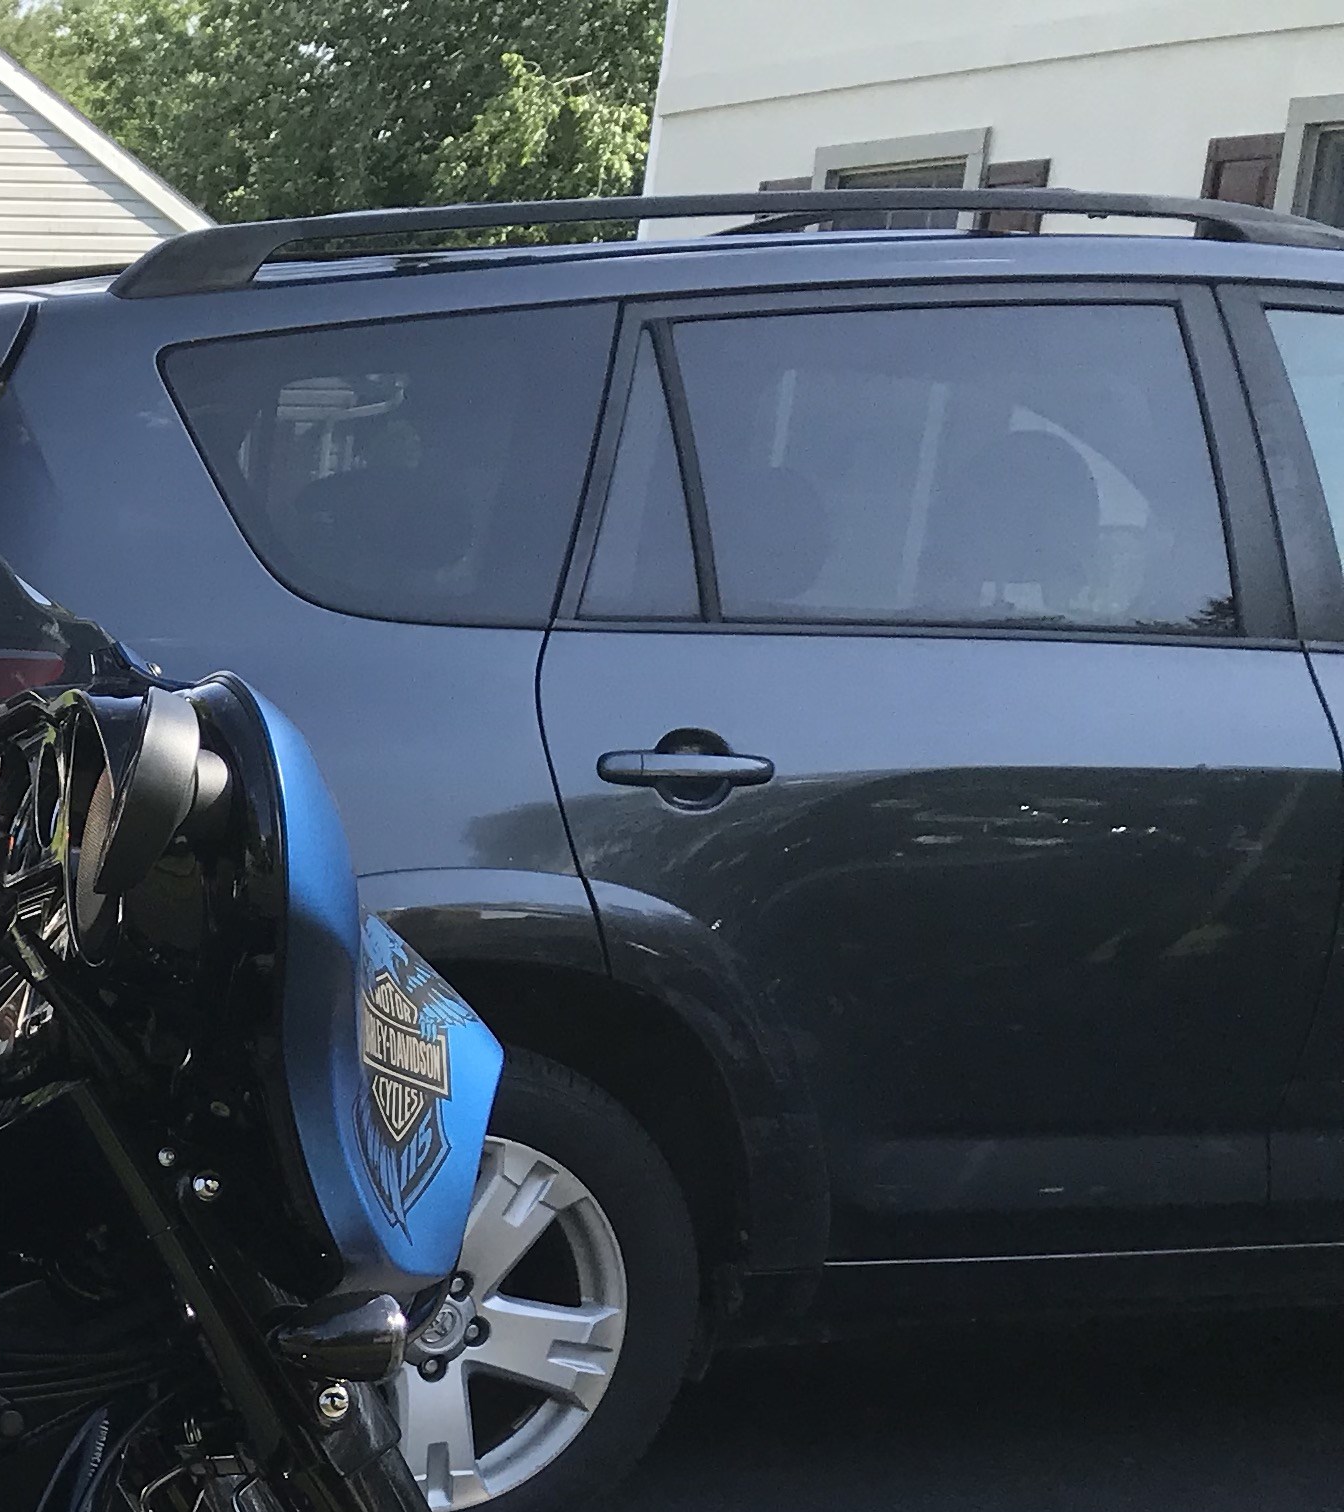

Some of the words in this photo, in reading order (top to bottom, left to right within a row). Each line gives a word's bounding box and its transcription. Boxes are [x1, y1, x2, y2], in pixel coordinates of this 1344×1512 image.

[370, 982, 413, 1023] MOTOR
[364, 1008, 441, 1081] LEY-DAVIDSON
[378, 1077, 418, 1130] CYCLES
